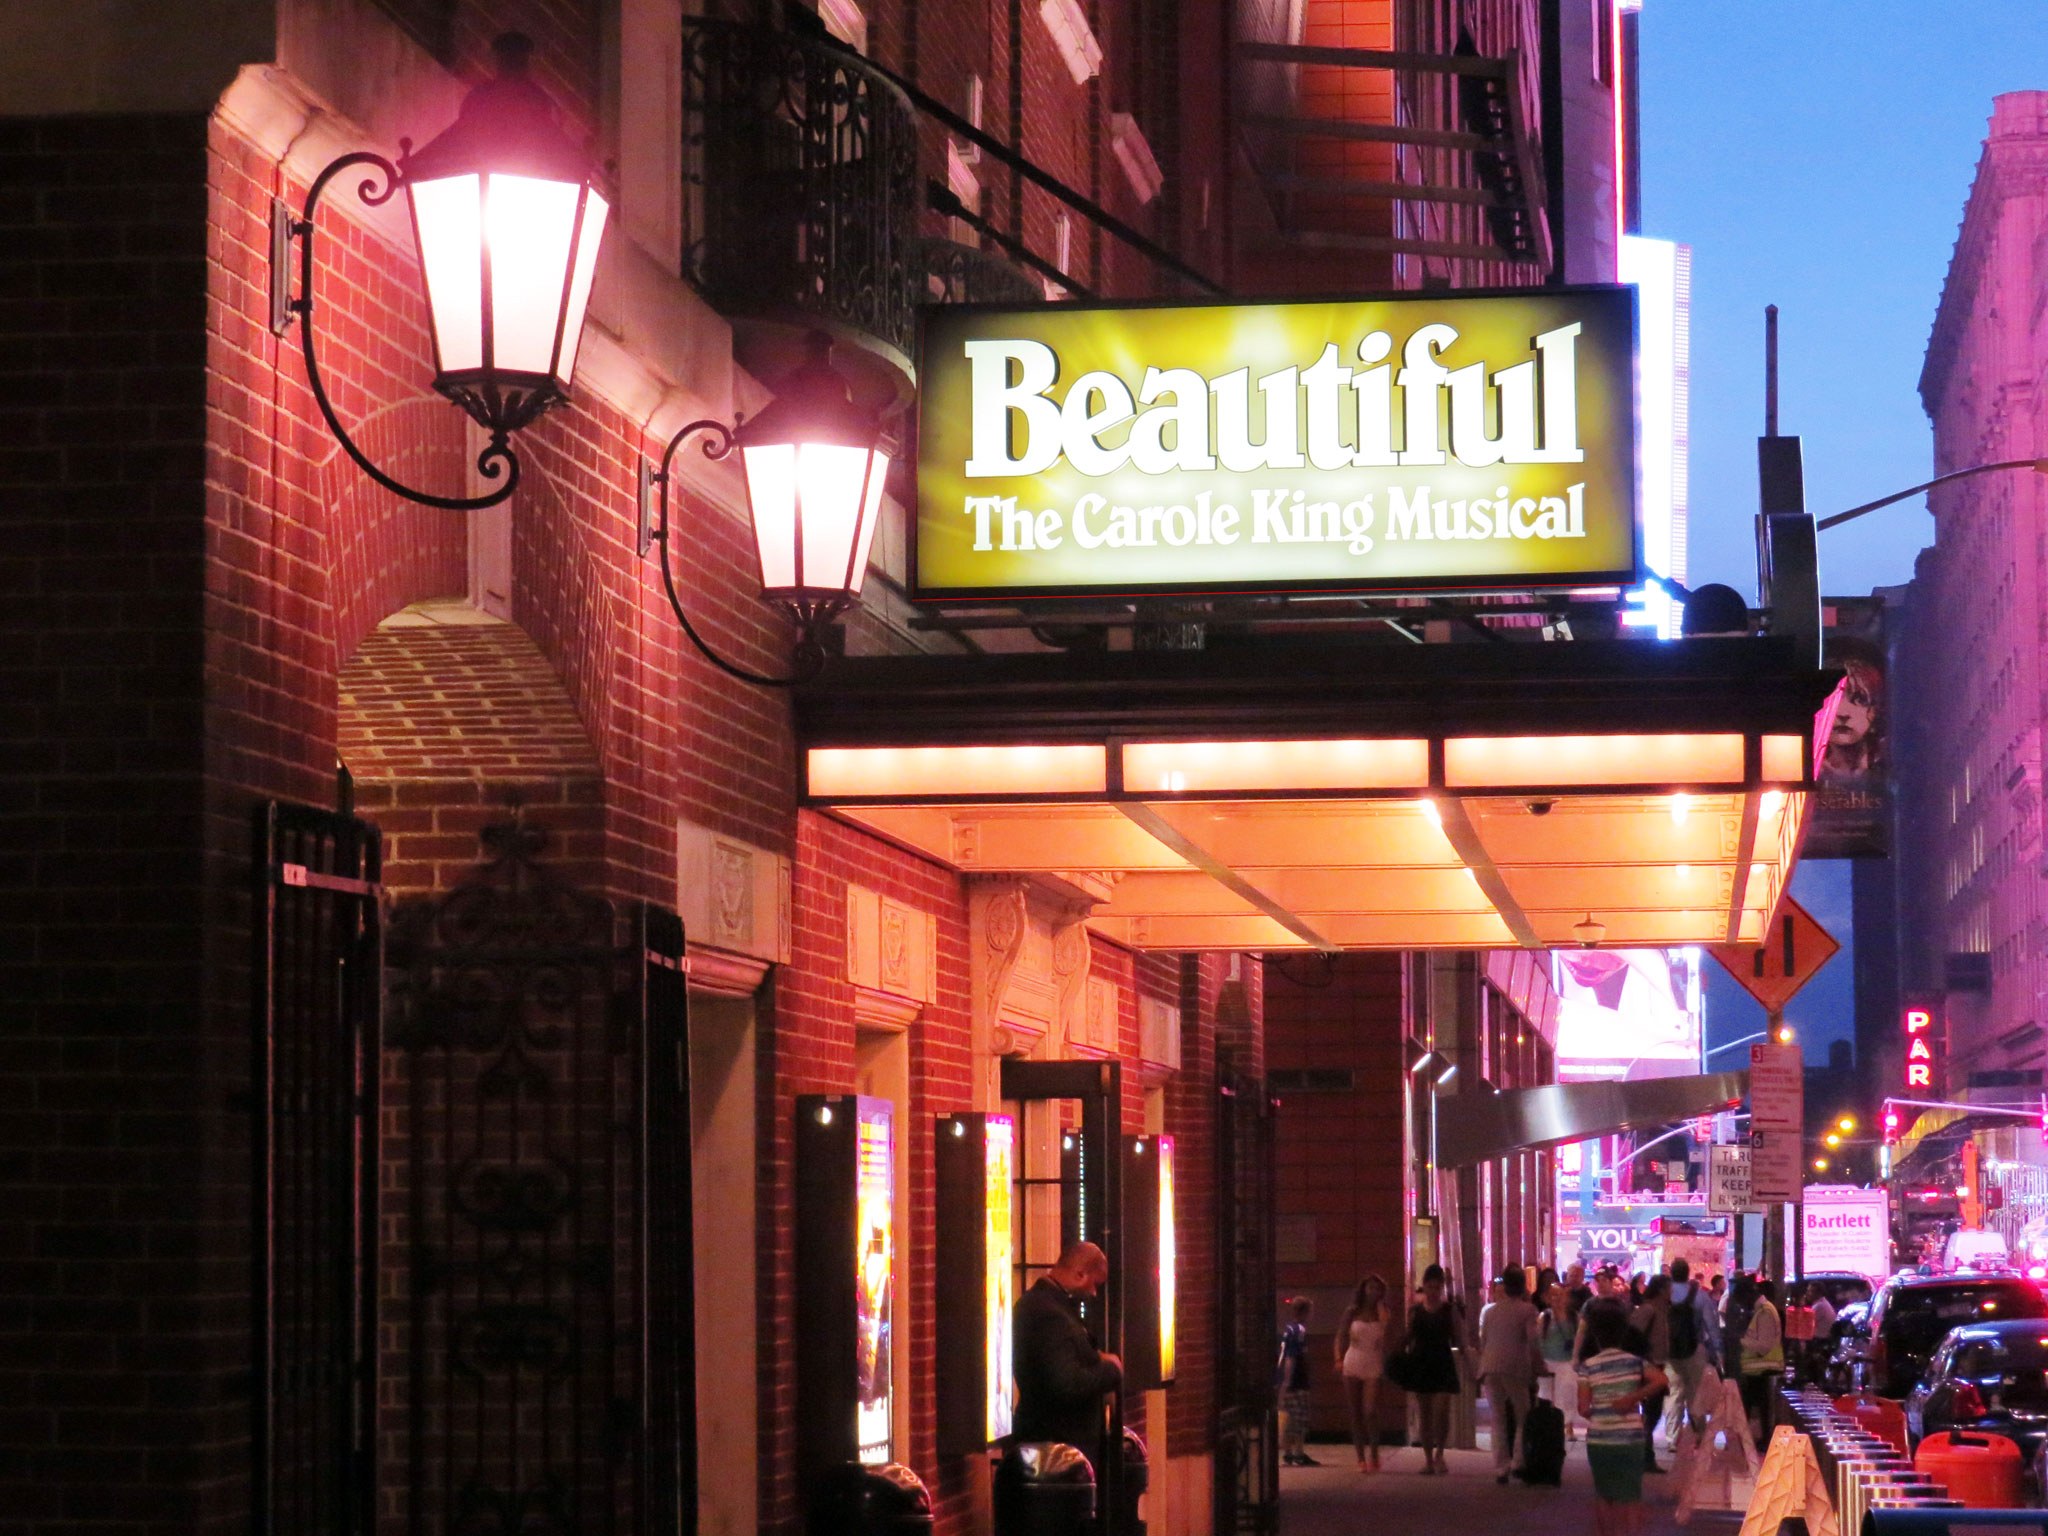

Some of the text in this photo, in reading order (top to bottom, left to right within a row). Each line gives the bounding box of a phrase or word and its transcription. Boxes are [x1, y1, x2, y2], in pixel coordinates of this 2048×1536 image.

[964, 321, 1584, 478] Beautiful
[964, 481, 1586, 556] The Carole King Musical
[1753, 1132, 1762, 1148] 6
[1807, 1213, 1871, 1229] Bartlett
